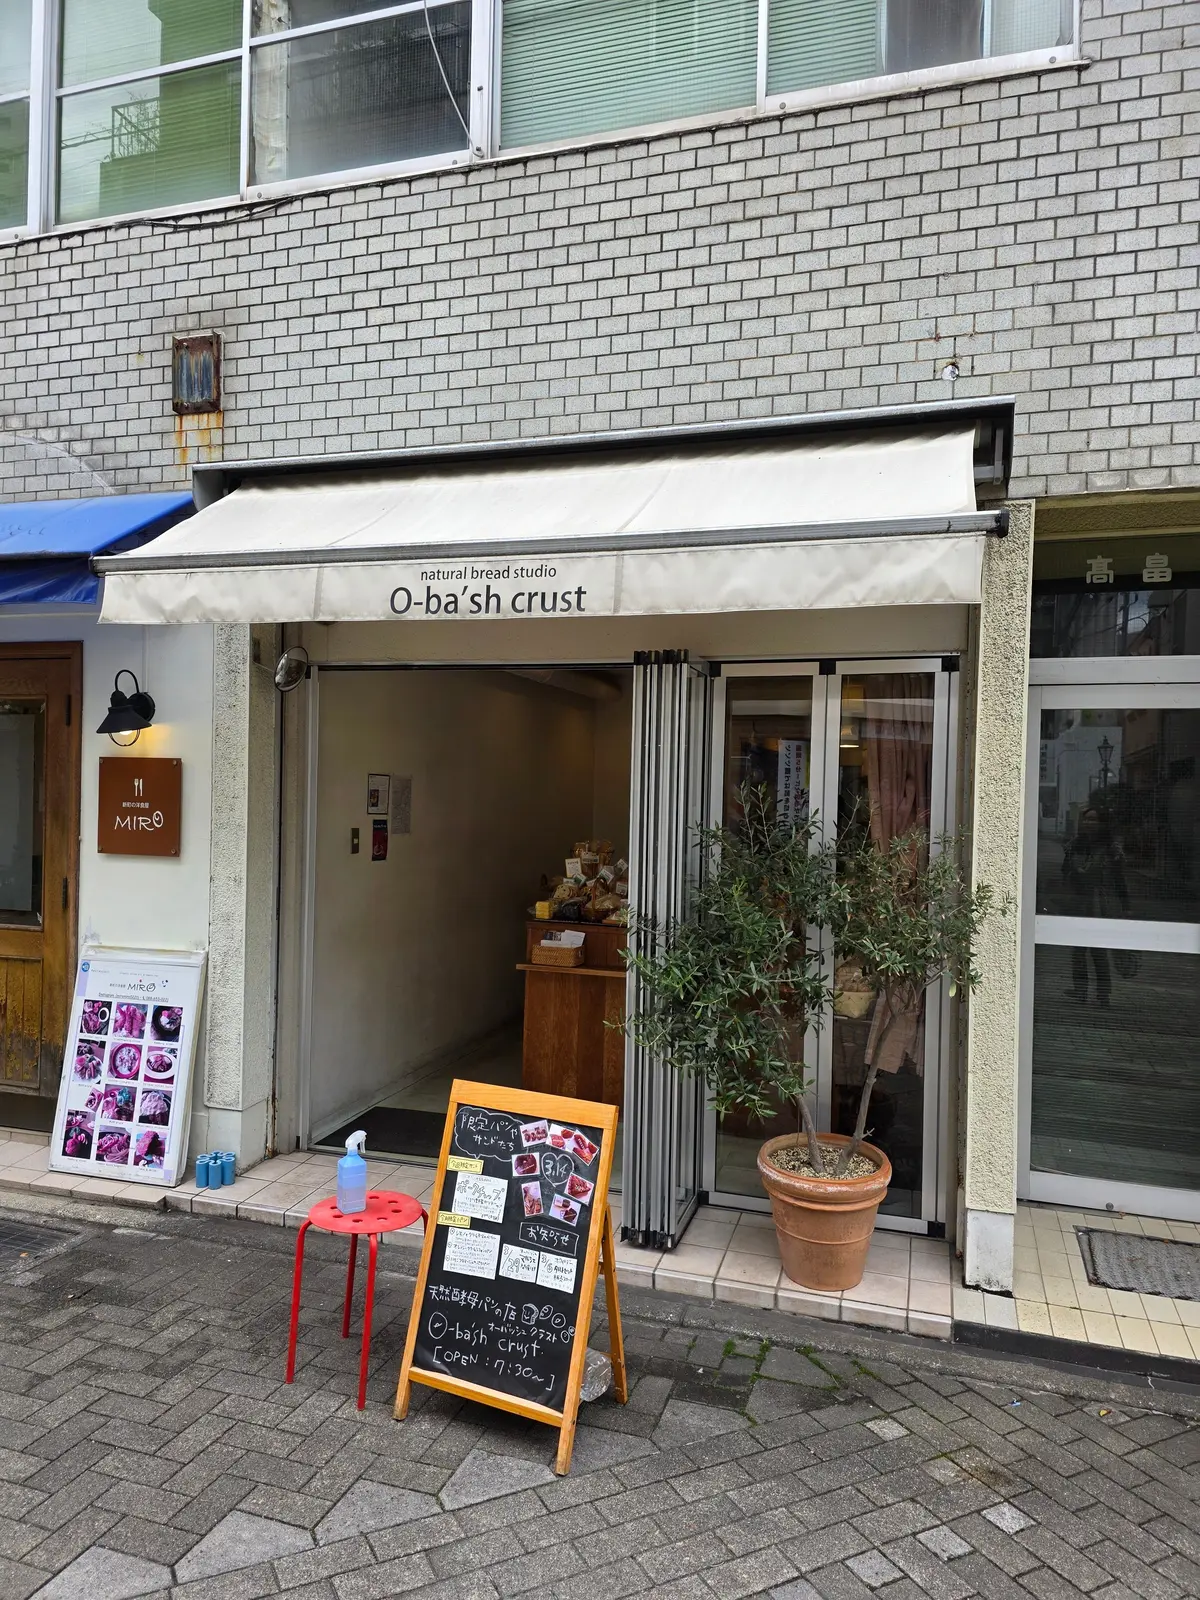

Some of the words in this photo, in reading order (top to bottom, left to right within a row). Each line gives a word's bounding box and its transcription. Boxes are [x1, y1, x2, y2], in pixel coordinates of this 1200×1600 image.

[420, 566, 468, 581] natural
[470, 565, 510, 580] bread
[513, 564, 557, 579] studio
[389, 584, 501, 615] O-ba'sh
[511, 585, 587, 613] crust
[113, 810, 164, 831] MIRO
[127, 982, 156, 992] MIRO
[473, 1134, 515, 1152] サンドたち
[545, 1160, 568, 1178] 3.14
[527, 1225, 570, 1246] お知らせ
[429, 1284, 517, 1322] 天然酵母パンの店
